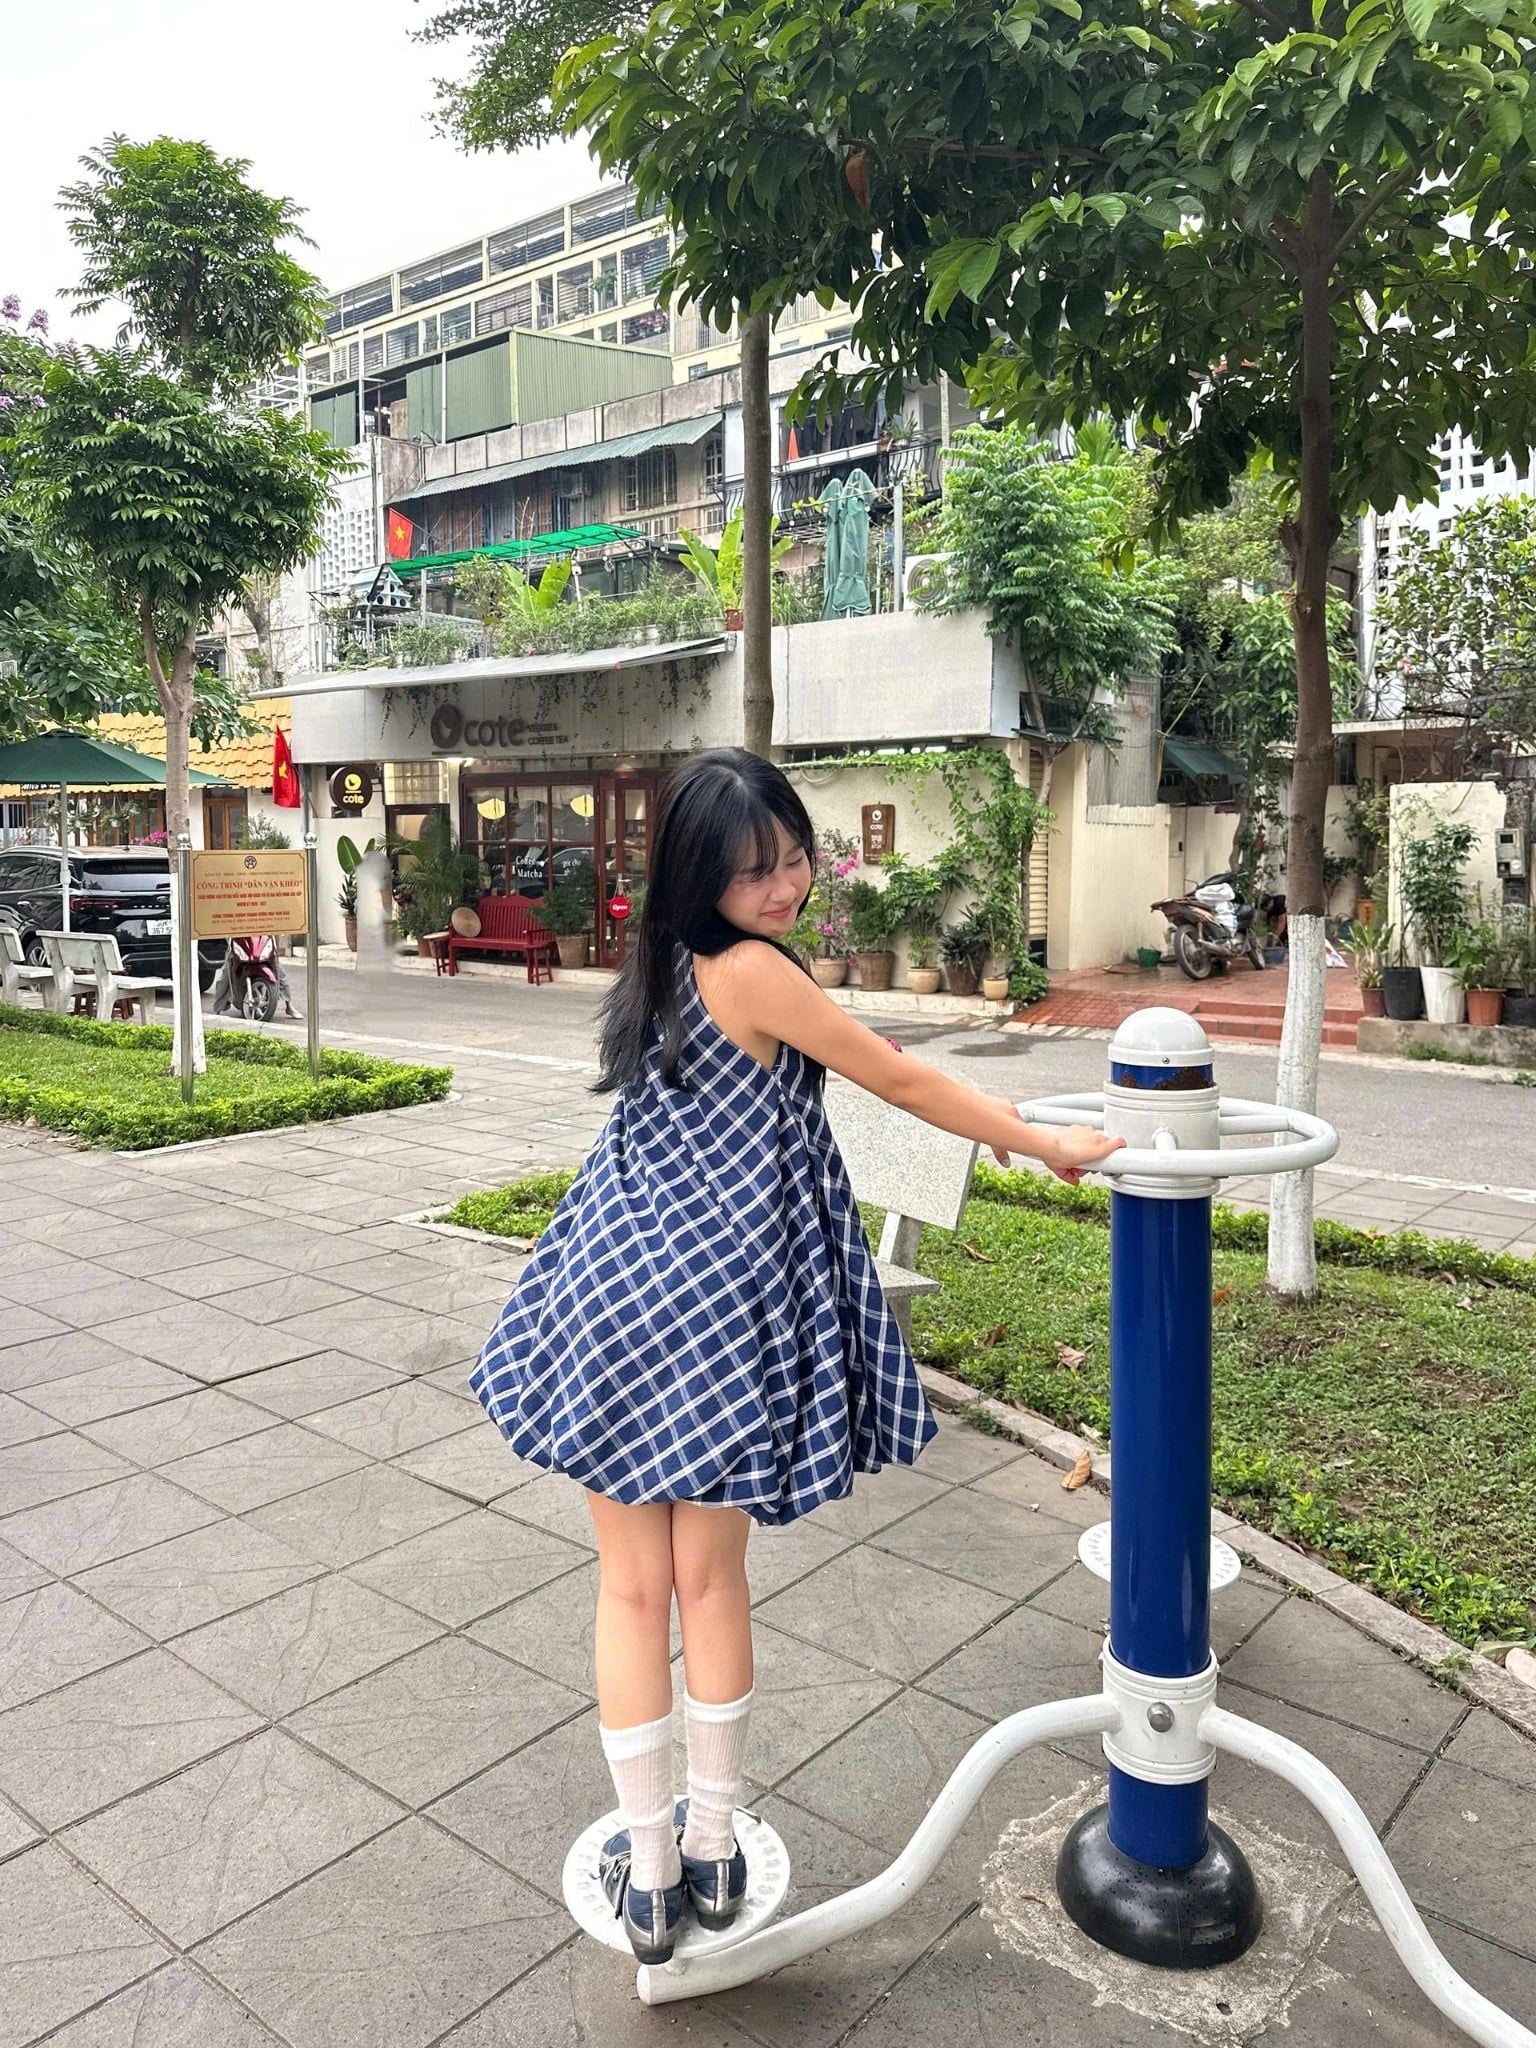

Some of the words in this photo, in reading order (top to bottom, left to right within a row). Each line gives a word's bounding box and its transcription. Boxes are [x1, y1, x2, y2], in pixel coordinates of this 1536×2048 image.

[463, 715, 524, 748] cote
[555, 735, 568, 744] TEA
[343, 794, 364, 804] cote
[517, 868, 543, 878] Matcha
[196, 880, 219, 890] CÔNG
